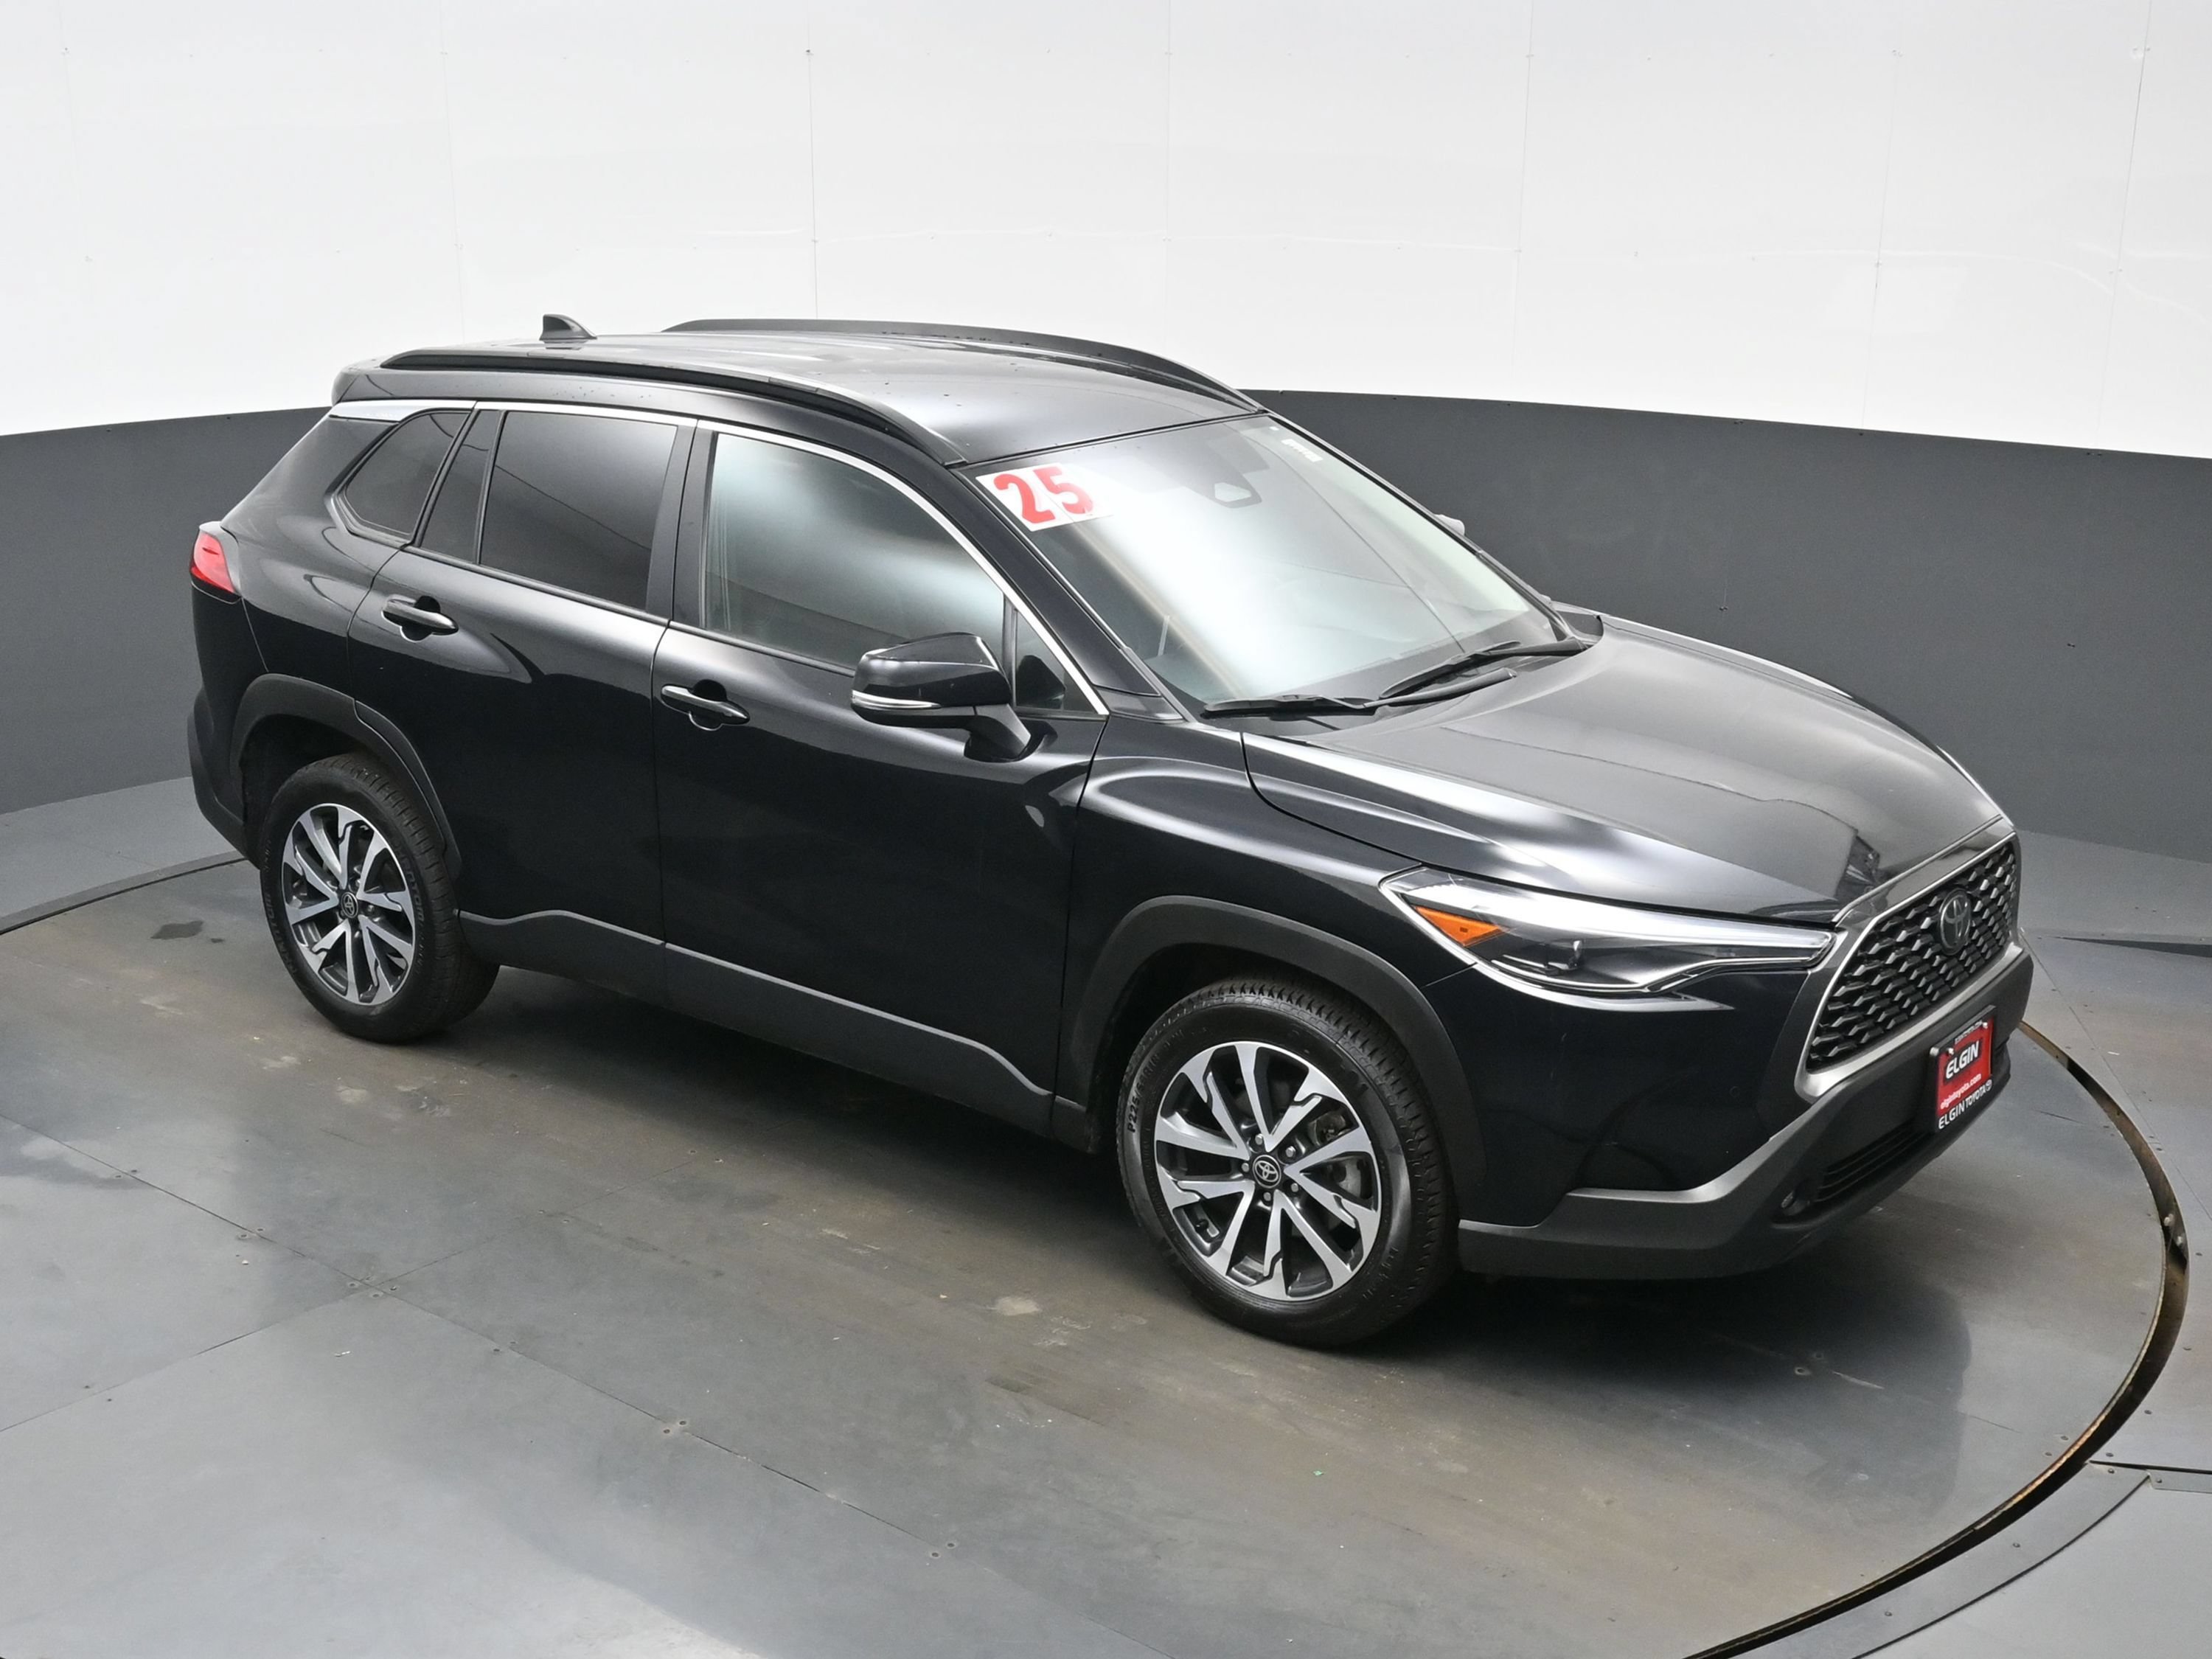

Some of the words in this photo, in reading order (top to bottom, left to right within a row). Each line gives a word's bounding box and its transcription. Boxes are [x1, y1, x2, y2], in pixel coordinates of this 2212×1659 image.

[993, 466, 1093, 524] 25
[1945, 1040, 1979, 1079] ELGIN
[1938, 1100, 1965, 1130] ELGIN
[1965, 1085, 1986, 1108] TOYOTA
[1940, 1073, 1982, 1110] elgintoyota.com
